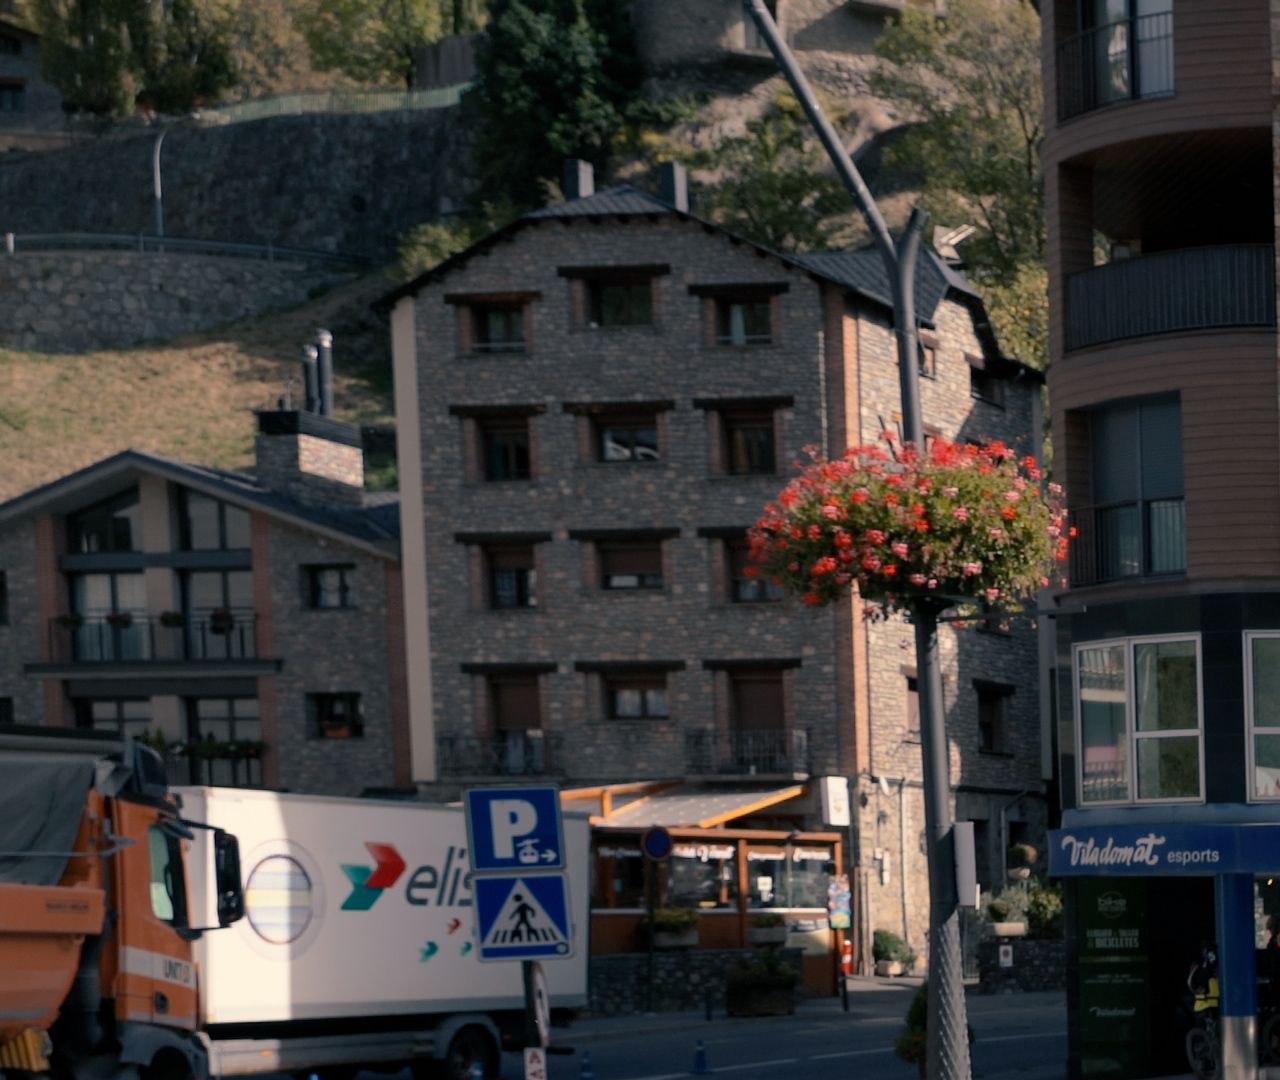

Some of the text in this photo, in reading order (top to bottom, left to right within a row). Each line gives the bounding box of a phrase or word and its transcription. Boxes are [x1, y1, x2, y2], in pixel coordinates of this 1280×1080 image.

[489, 799, 538, 859] P
[1061, 833, 1220, 866] Viladomat esports
